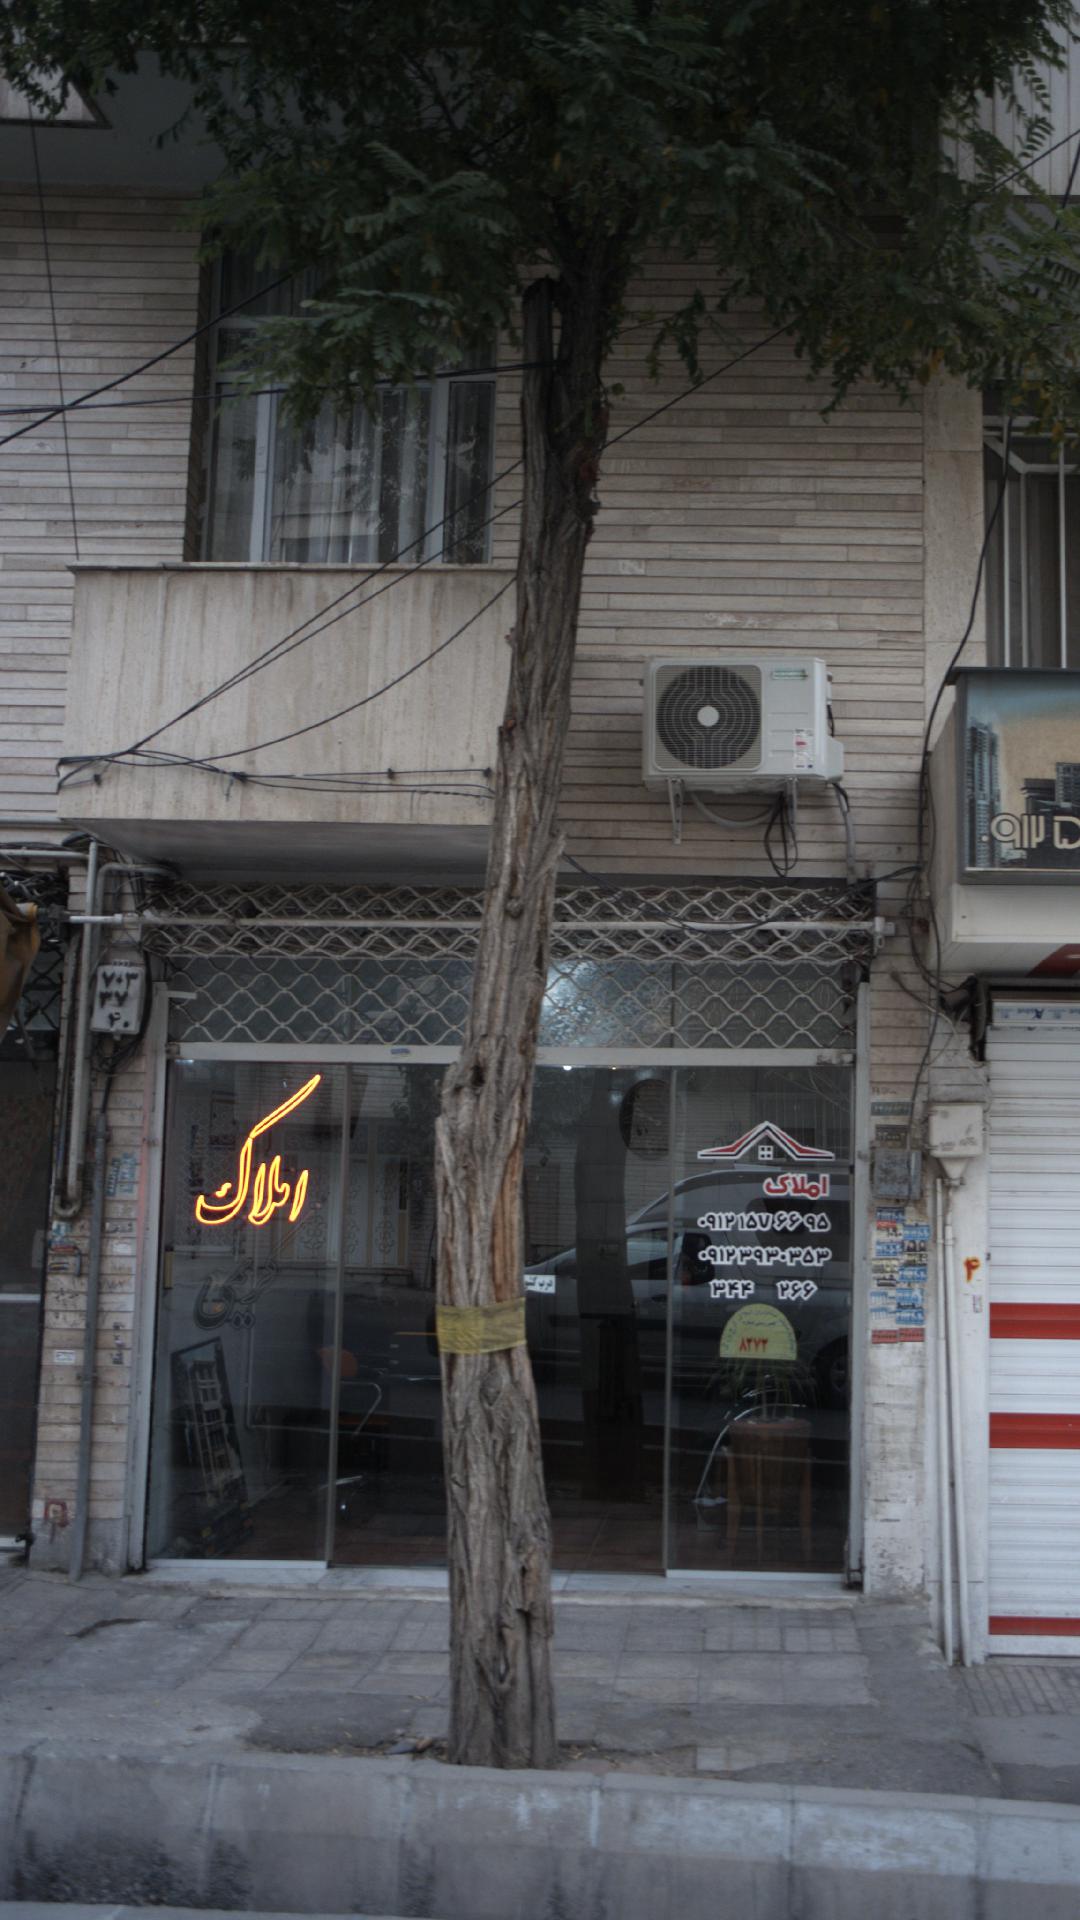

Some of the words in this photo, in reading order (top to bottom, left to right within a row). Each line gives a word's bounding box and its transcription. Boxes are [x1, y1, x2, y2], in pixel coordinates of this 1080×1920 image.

[195, 1074, 321, 1225] املاک
[763, 1173, 829, 1200] املاک
[710, 1279, 755, 1299] ۳۴۴
[776, 1279, 818, 1301] ۲۶۶
